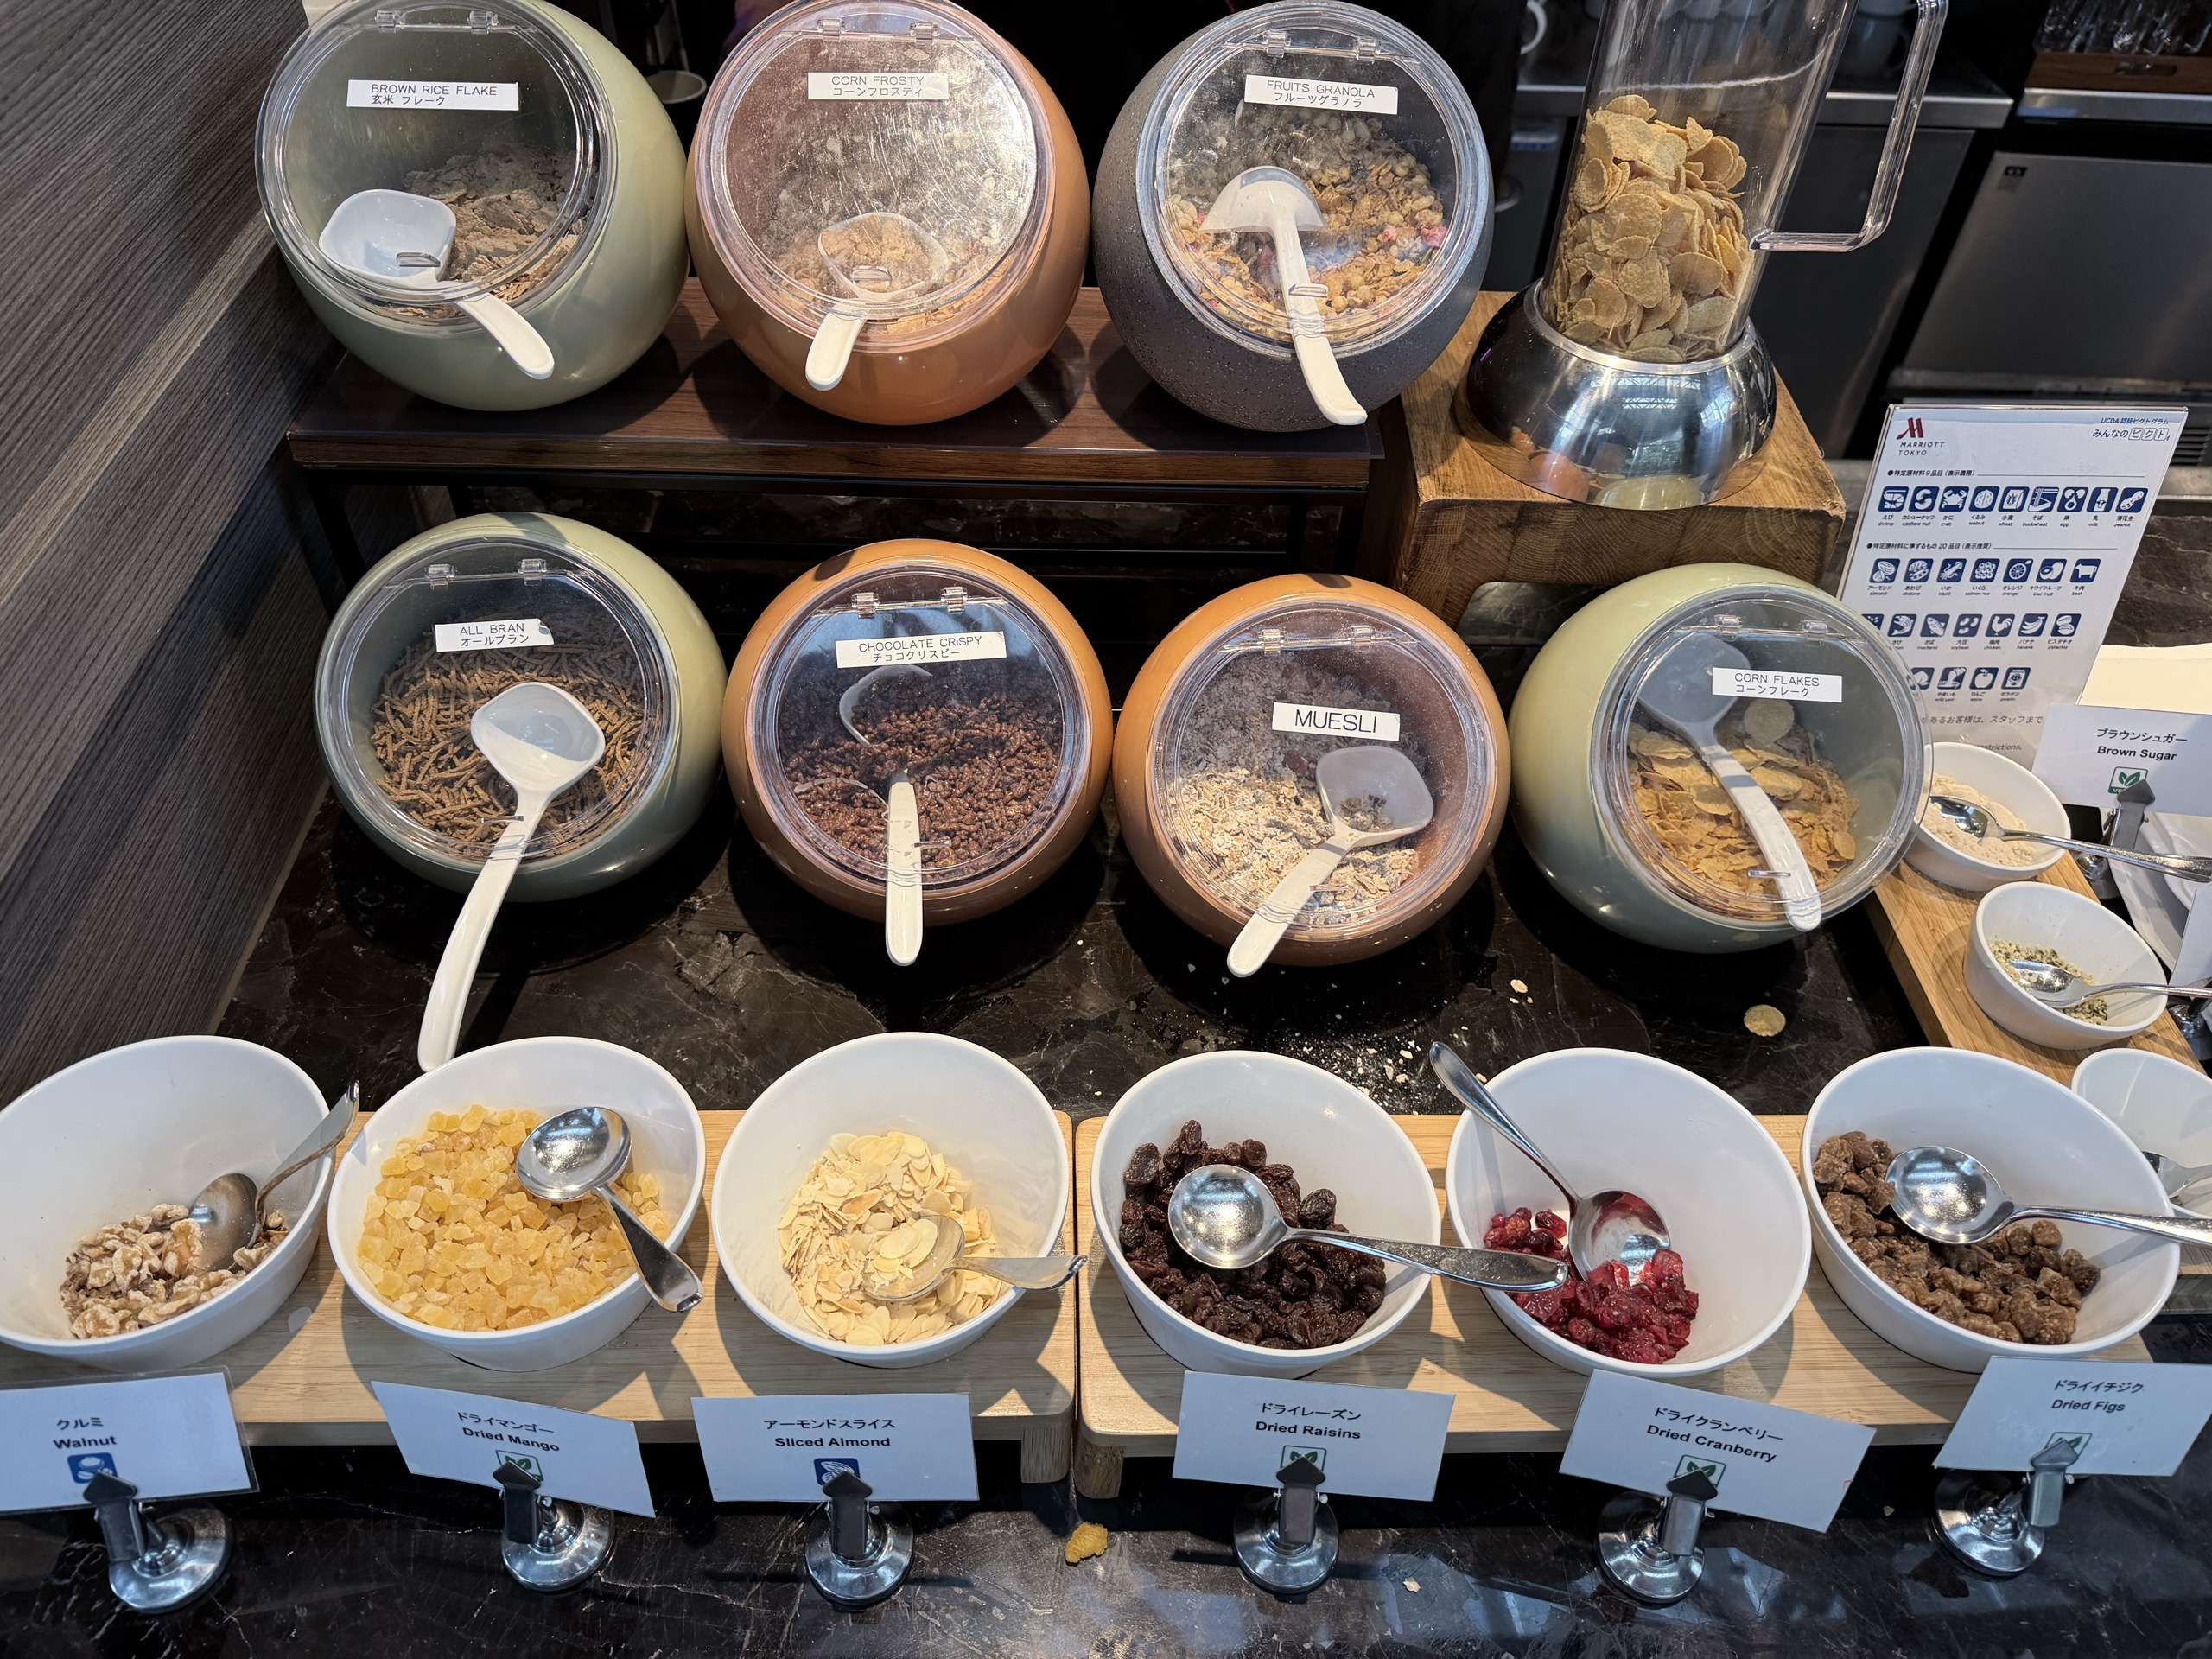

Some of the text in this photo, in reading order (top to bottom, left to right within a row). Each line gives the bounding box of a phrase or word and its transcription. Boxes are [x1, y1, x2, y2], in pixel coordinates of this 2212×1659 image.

[831, 76, 925, 86] CORN FROSTY
[1267, 79, 1376, 98] FRUITS GRANOLA
[371, 84, 497, 96] BROWN RICE FLAKE
[833, 88, 923, 97] コーンフロスティ
[371, 95, 446, 105] 玄米 フレーク
[1274, 92, 1362, 108] フルーツグラノラ
[460, 623, 524, 636] ALL BRAN
[461, 634, 529, 647] オールブラン
[858, 636, 982, 652] CHOCOLATE CRISPY
[873, 648, 960, 663] チョコクリスピー
[1734, 672, 1820, 687] CORN FLAKES
[1736, 684, 1809, 697] コーンフレーク
[1295, 709, 1377, 734] MUESLI
[2097, 728, 2187, 744] ブラウンシュガー
[2097, 746, 2177, 761] Brown Sugar
[2054, 1380, 2145, 1394] ドライイチジク
[1262, 1402, 1362, 1421] ドライレーズン
[2050, 1399, 2126, 1414] Dried Figs
[56, 1417, 104, 1431] クルミ
[457, 1411, 555, 1433] ドライマンゴー
[764, 1418, 896, 1430] アーモンドスライス
[1654, 1407, 1783, 1441] ドライクランベリー
[1255, 1421, 1361, 1440] Dried Raisins
[53, 1435, 118, 1449] Walnut
[462, 1427, 560, 1452] Dried Mango
[775, 1437, 891, 1447] Sliced Almond
[1647, 1424, 1777, 1463] Dried Cranberry
